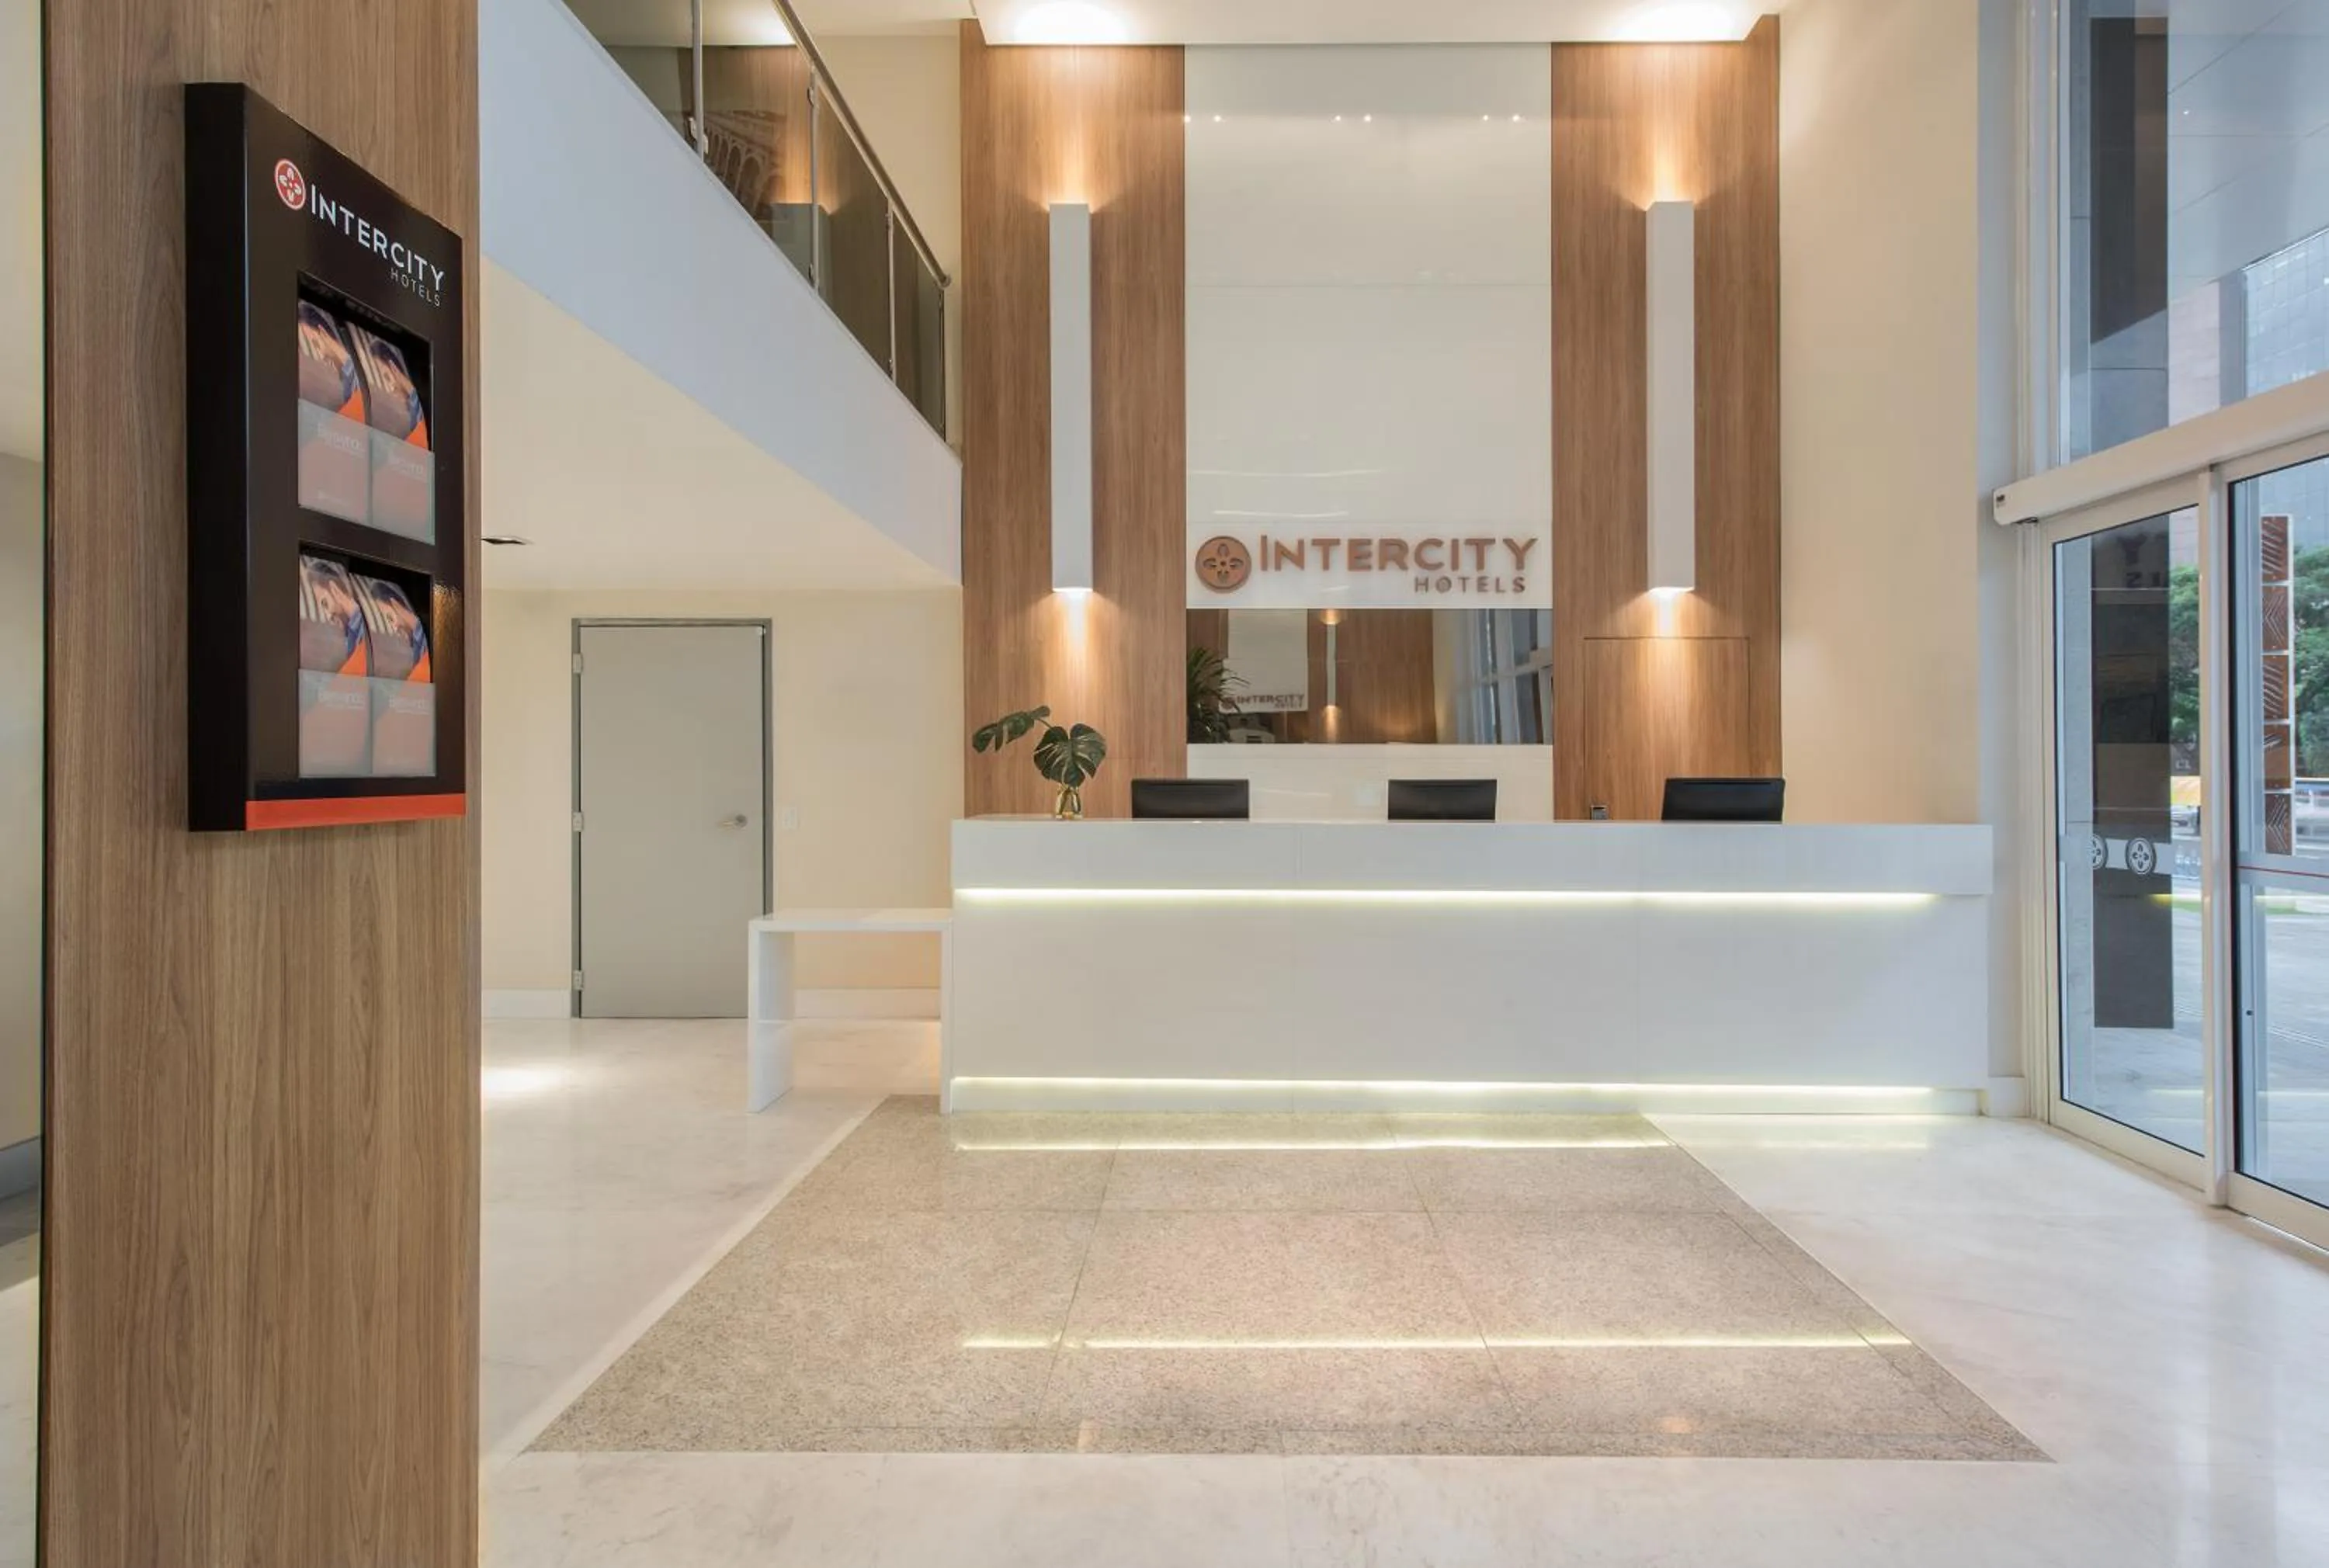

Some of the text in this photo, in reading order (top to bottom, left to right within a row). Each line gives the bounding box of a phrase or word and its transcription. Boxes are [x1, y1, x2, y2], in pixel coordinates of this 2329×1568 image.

[311, 183, 444, 291] INTERCITY
[390, 267, 440, 307] HOTELS
[1260, 534, 1538, 571] INTERCITY
[1414, 576, 1525, 594] HOTELS
